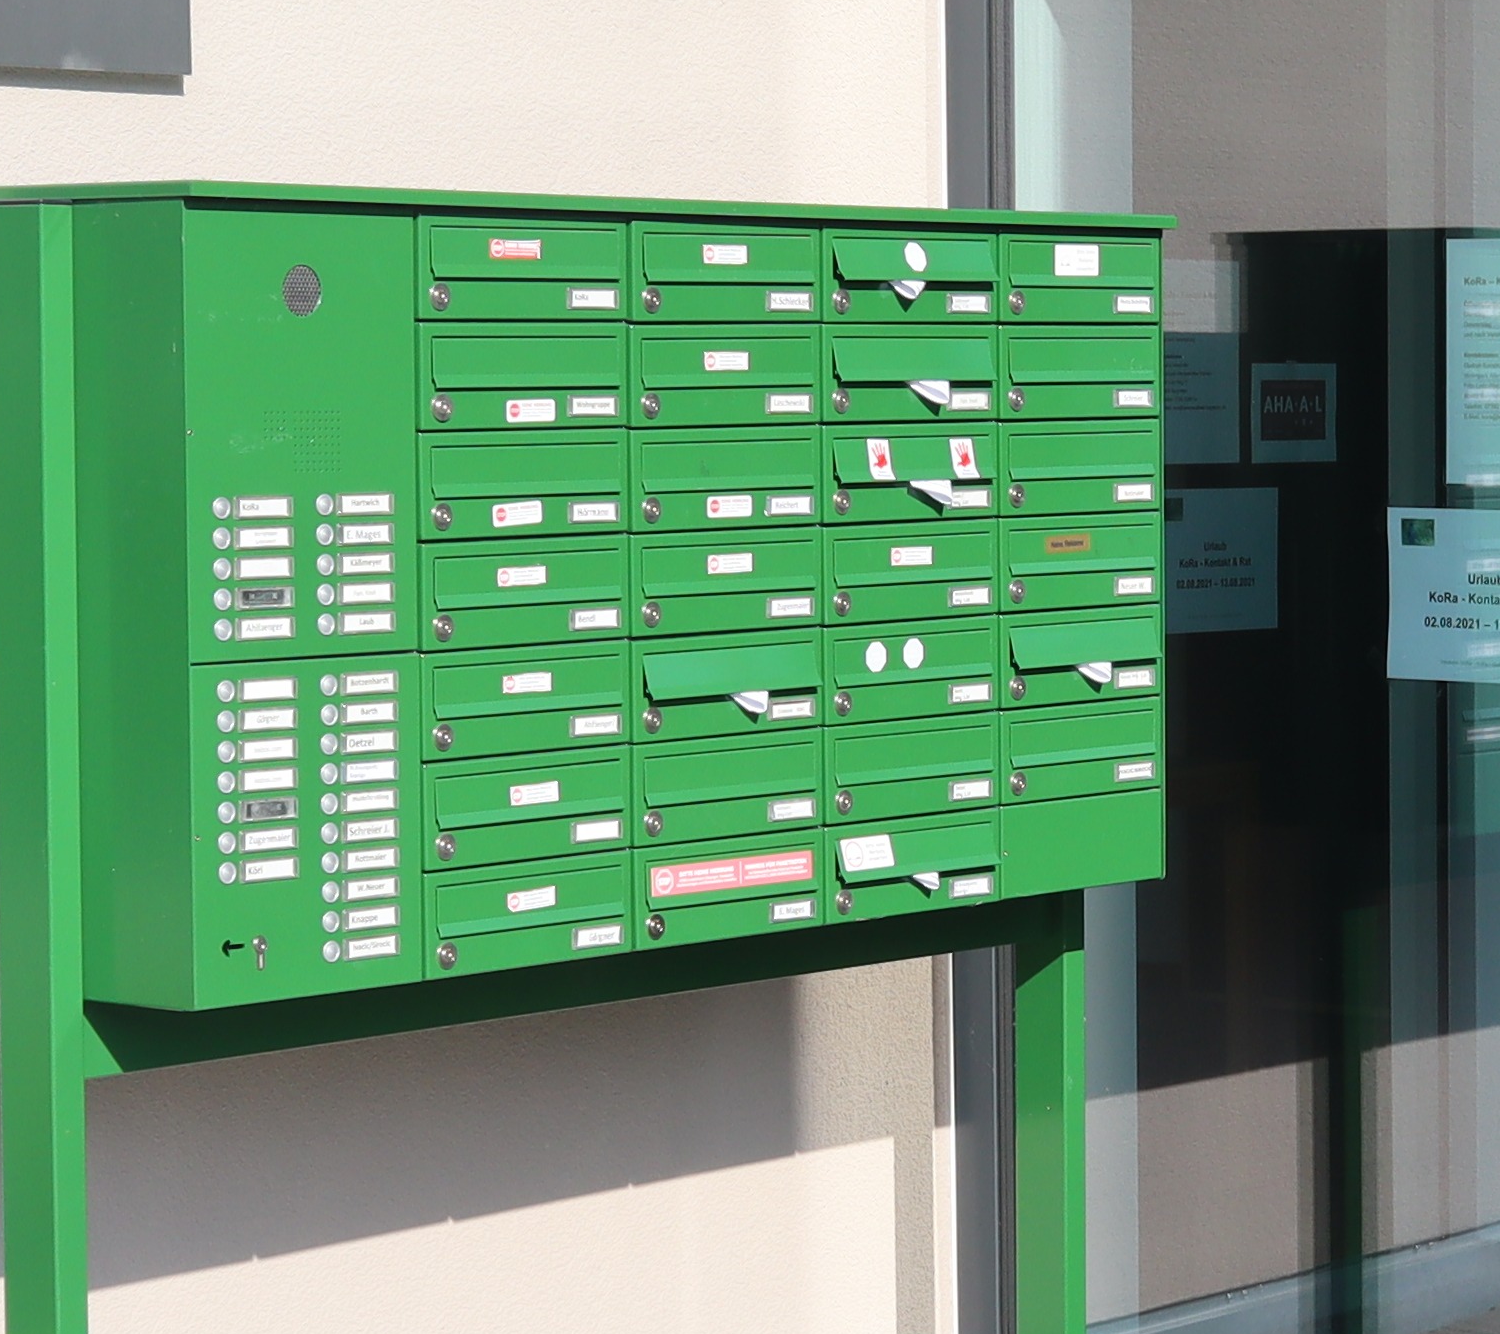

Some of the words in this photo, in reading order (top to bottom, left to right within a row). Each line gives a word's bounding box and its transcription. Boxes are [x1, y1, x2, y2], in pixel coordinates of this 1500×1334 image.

[1429, 592, 1458, 603] KoRa
[1424, 617, 1480, 630] 02.08.2021
[349, 739, 374, 748] Oetzel
[351, 915, 378, 923] Knappe
